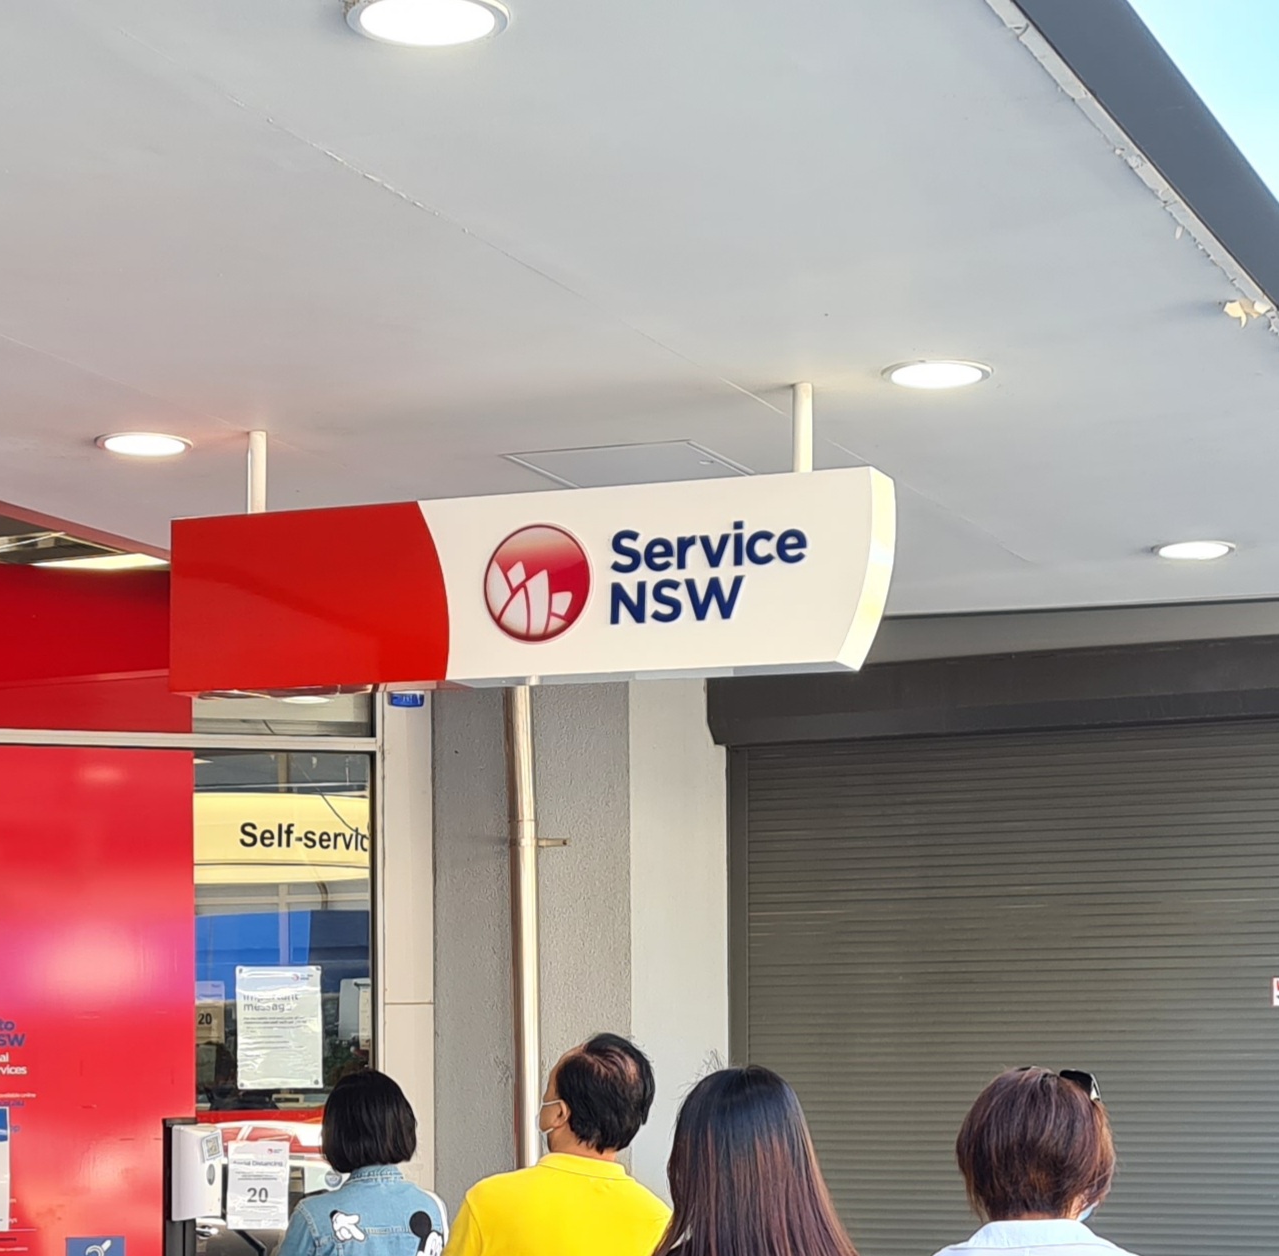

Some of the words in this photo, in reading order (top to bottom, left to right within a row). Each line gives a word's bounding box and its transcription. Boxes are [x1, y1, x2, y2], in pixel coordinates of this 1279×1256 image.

[610, 520, 808, 574] Service
[610, 575, 746, 625] NSW
[239, 822, 369, 852] Self-servic
[198, 1013, 212, 1025] 20
[247, 1187, 268, 1203] 20
